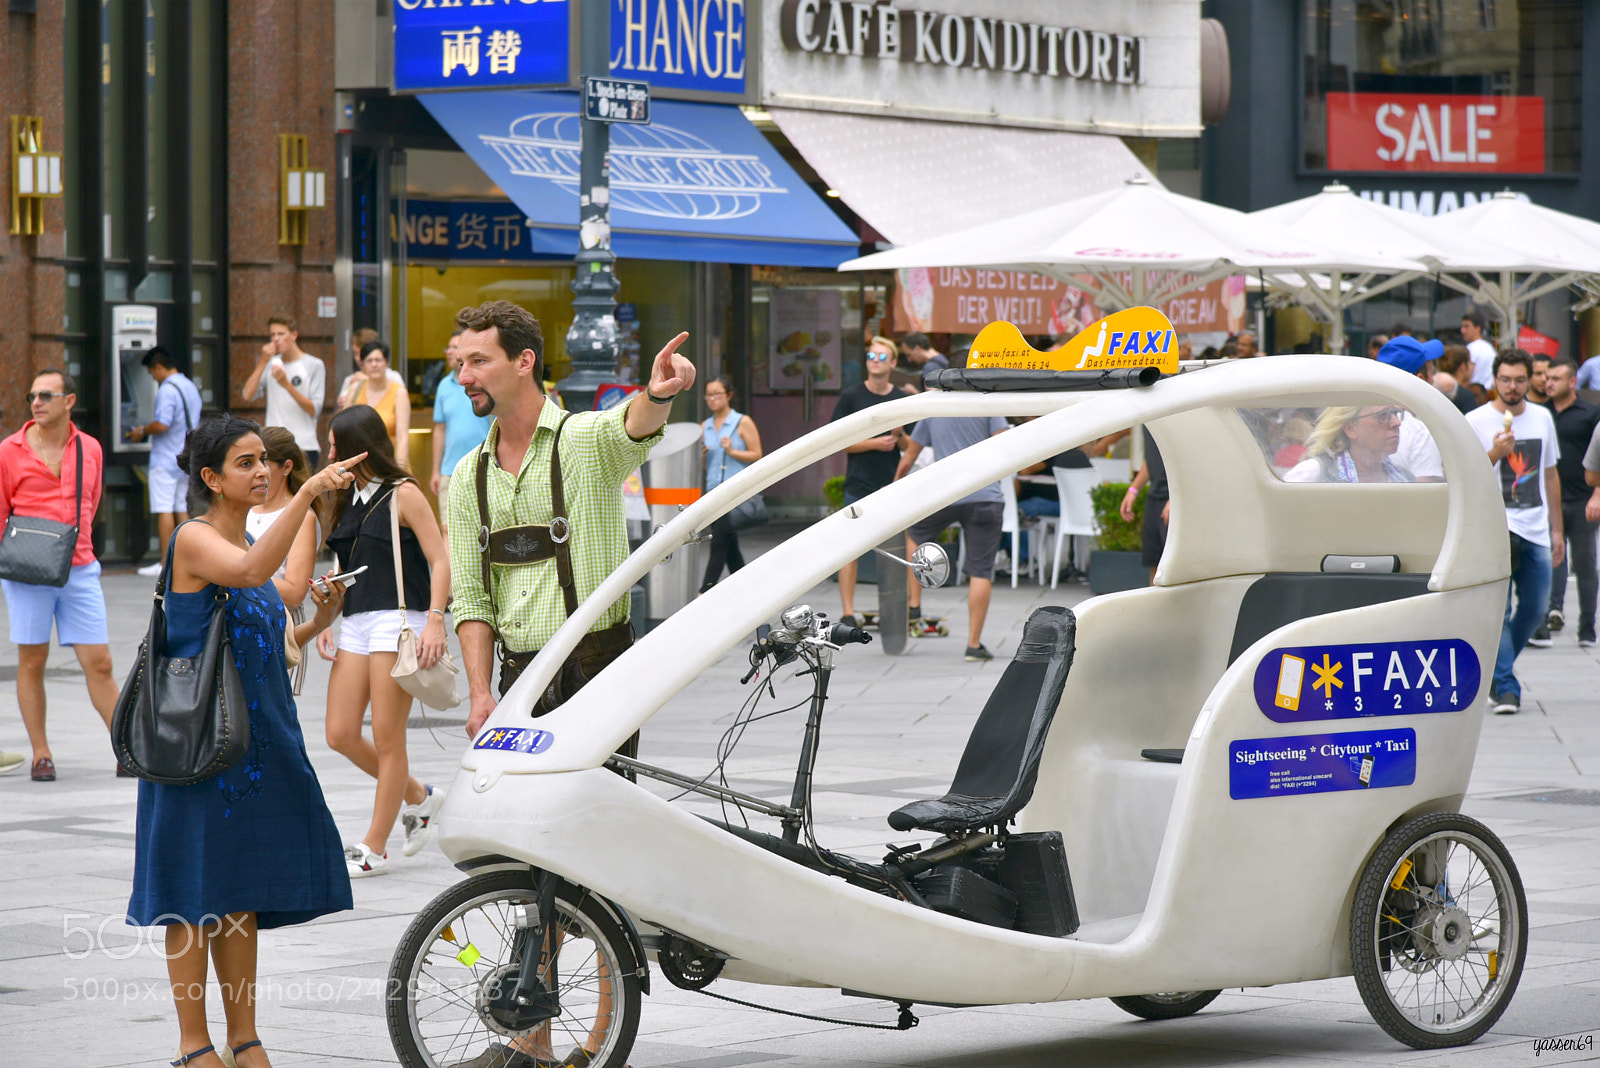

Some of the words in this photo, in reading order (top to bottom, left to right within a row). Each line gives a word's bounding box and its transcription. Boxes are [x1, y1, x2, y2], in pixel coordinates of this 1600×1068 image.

[440, 25, 522, 78] 両替
[914, 10, 1147, 85] KONDITOREI
[1375, 102, 1498, 164] SALE
[484, 141, 561, 175] THE
[551, 148, 685, 185] CNGE
[676, 157, 777, 188] GROUP
[455, 211, 523, 252] 货币
[940, 266, 972, 288] DAS
[976, 268, 1027, 291] BESTE
[957, 294, 988, 324] DER
[993, 296, 1043, 325] WELT!
[1168, 298, 1218, 325] CREAM
[980, 347, 1031, 360] www.faxi.at
[1107, 329, 1173, 356] FAXI
[1352, 647, 1458, 693] FAXI
[502, 730, 547, 747] FAXI
[1235, 747, 1307, 765] Sightseeing
[1320, 742, 1372, 758] Citytour
[1384, 739, 1409, 752] Taxi
